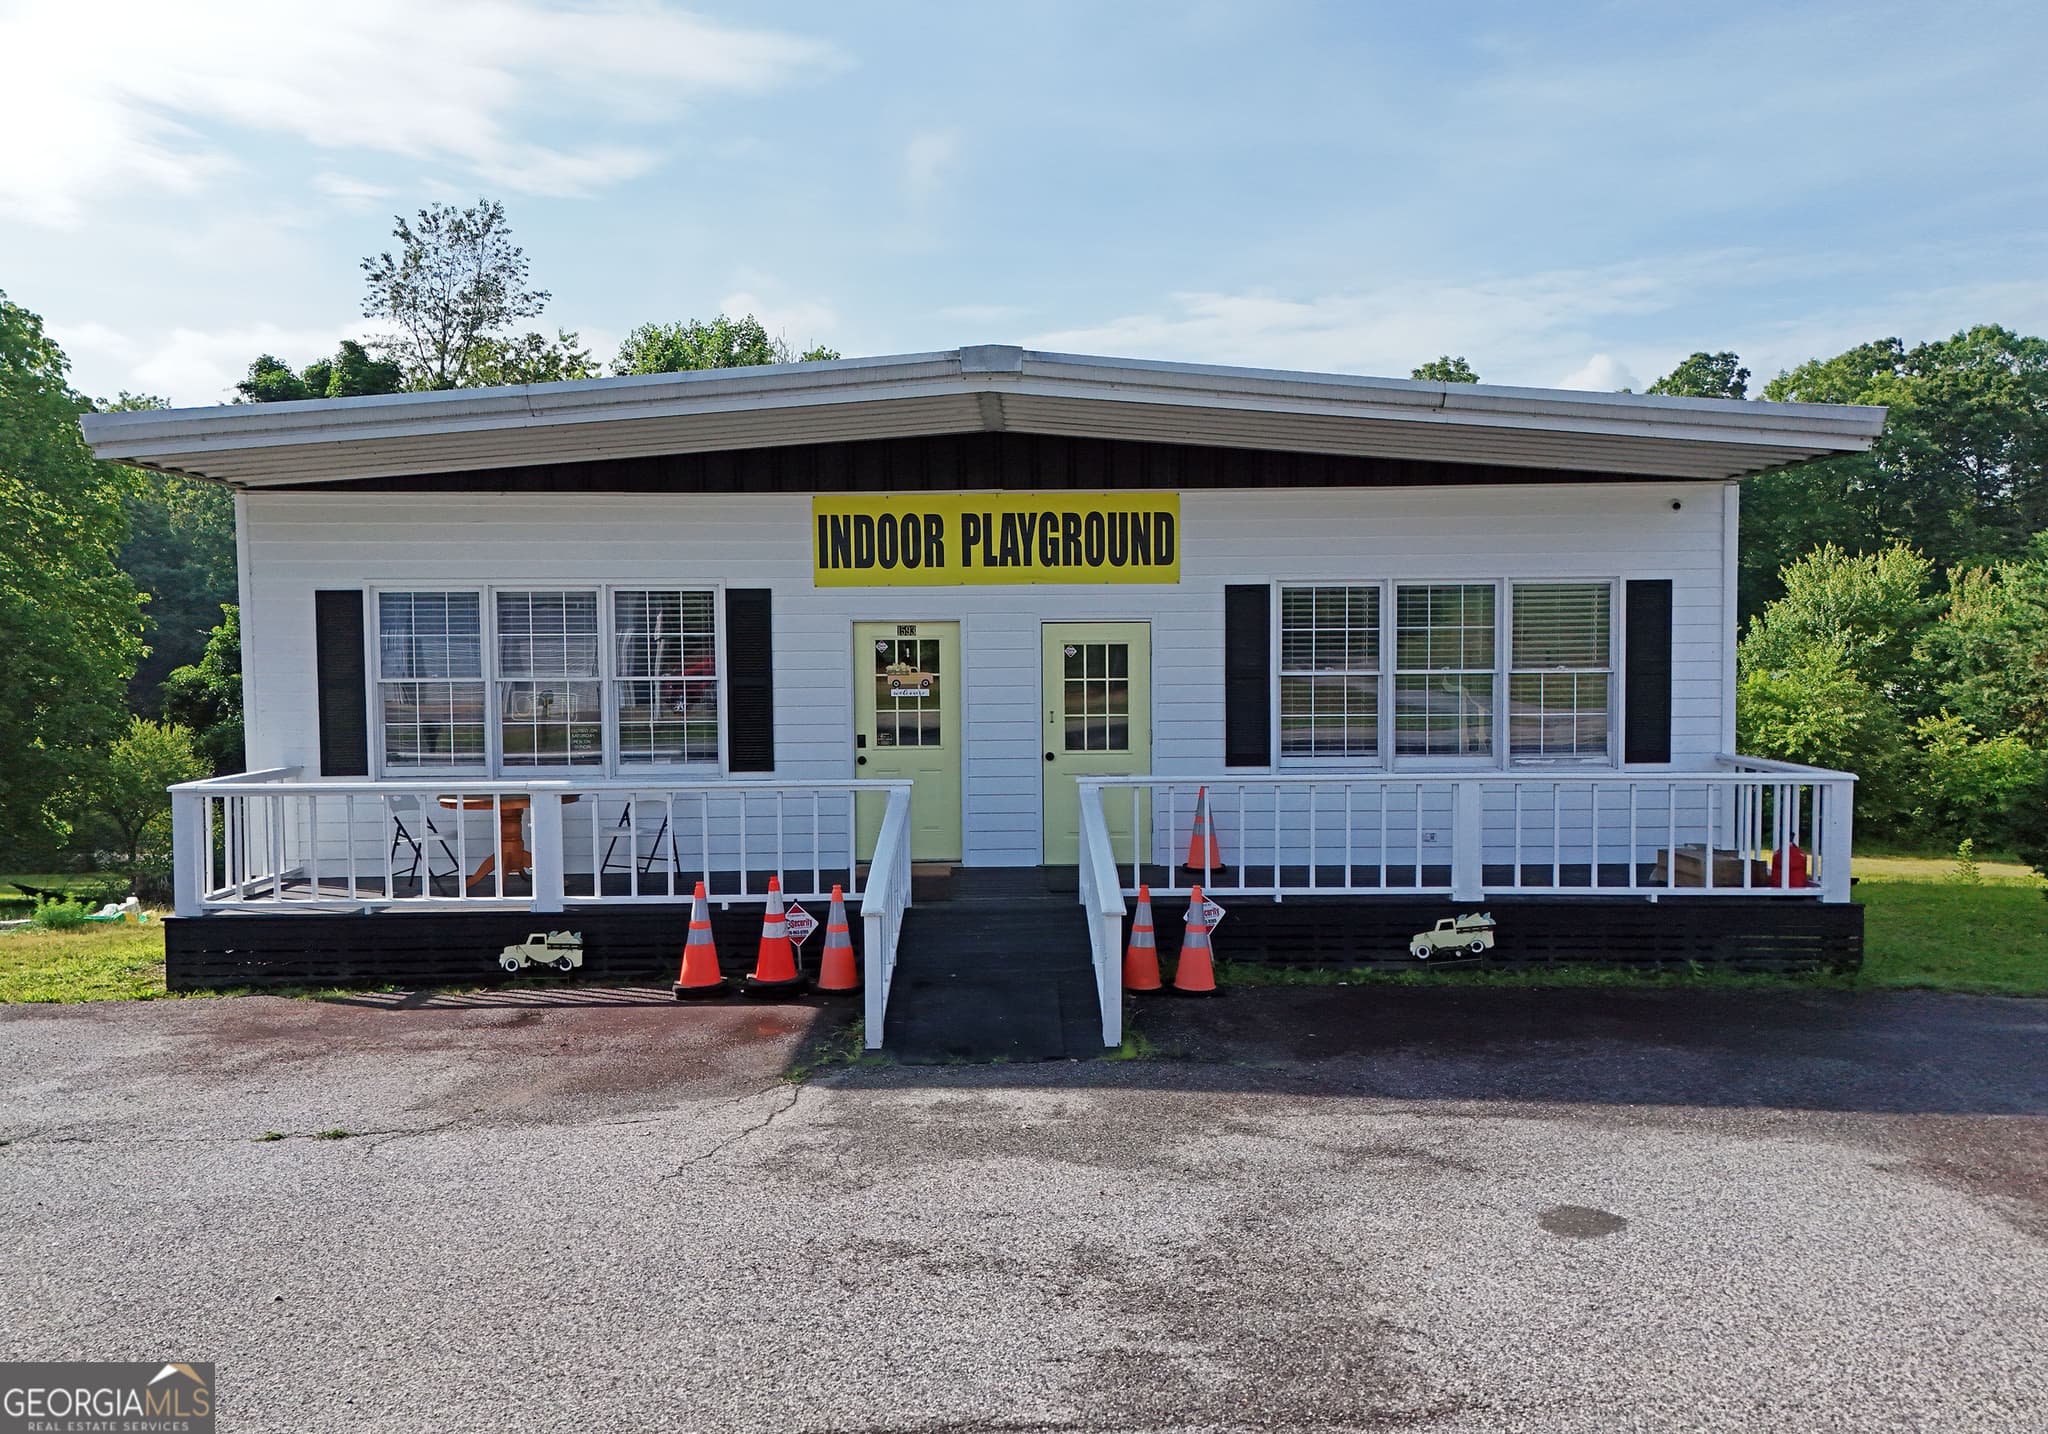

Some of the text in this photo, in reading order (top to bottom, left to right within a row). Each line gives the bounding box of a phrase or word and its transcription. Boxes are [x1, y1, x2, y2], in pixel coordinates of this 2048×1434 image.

[818, 511, 1175, 569] INDOOR PLAYGROUND
[898, 625, 916, 636] 1593
[790, 918, 813, 929] Security
